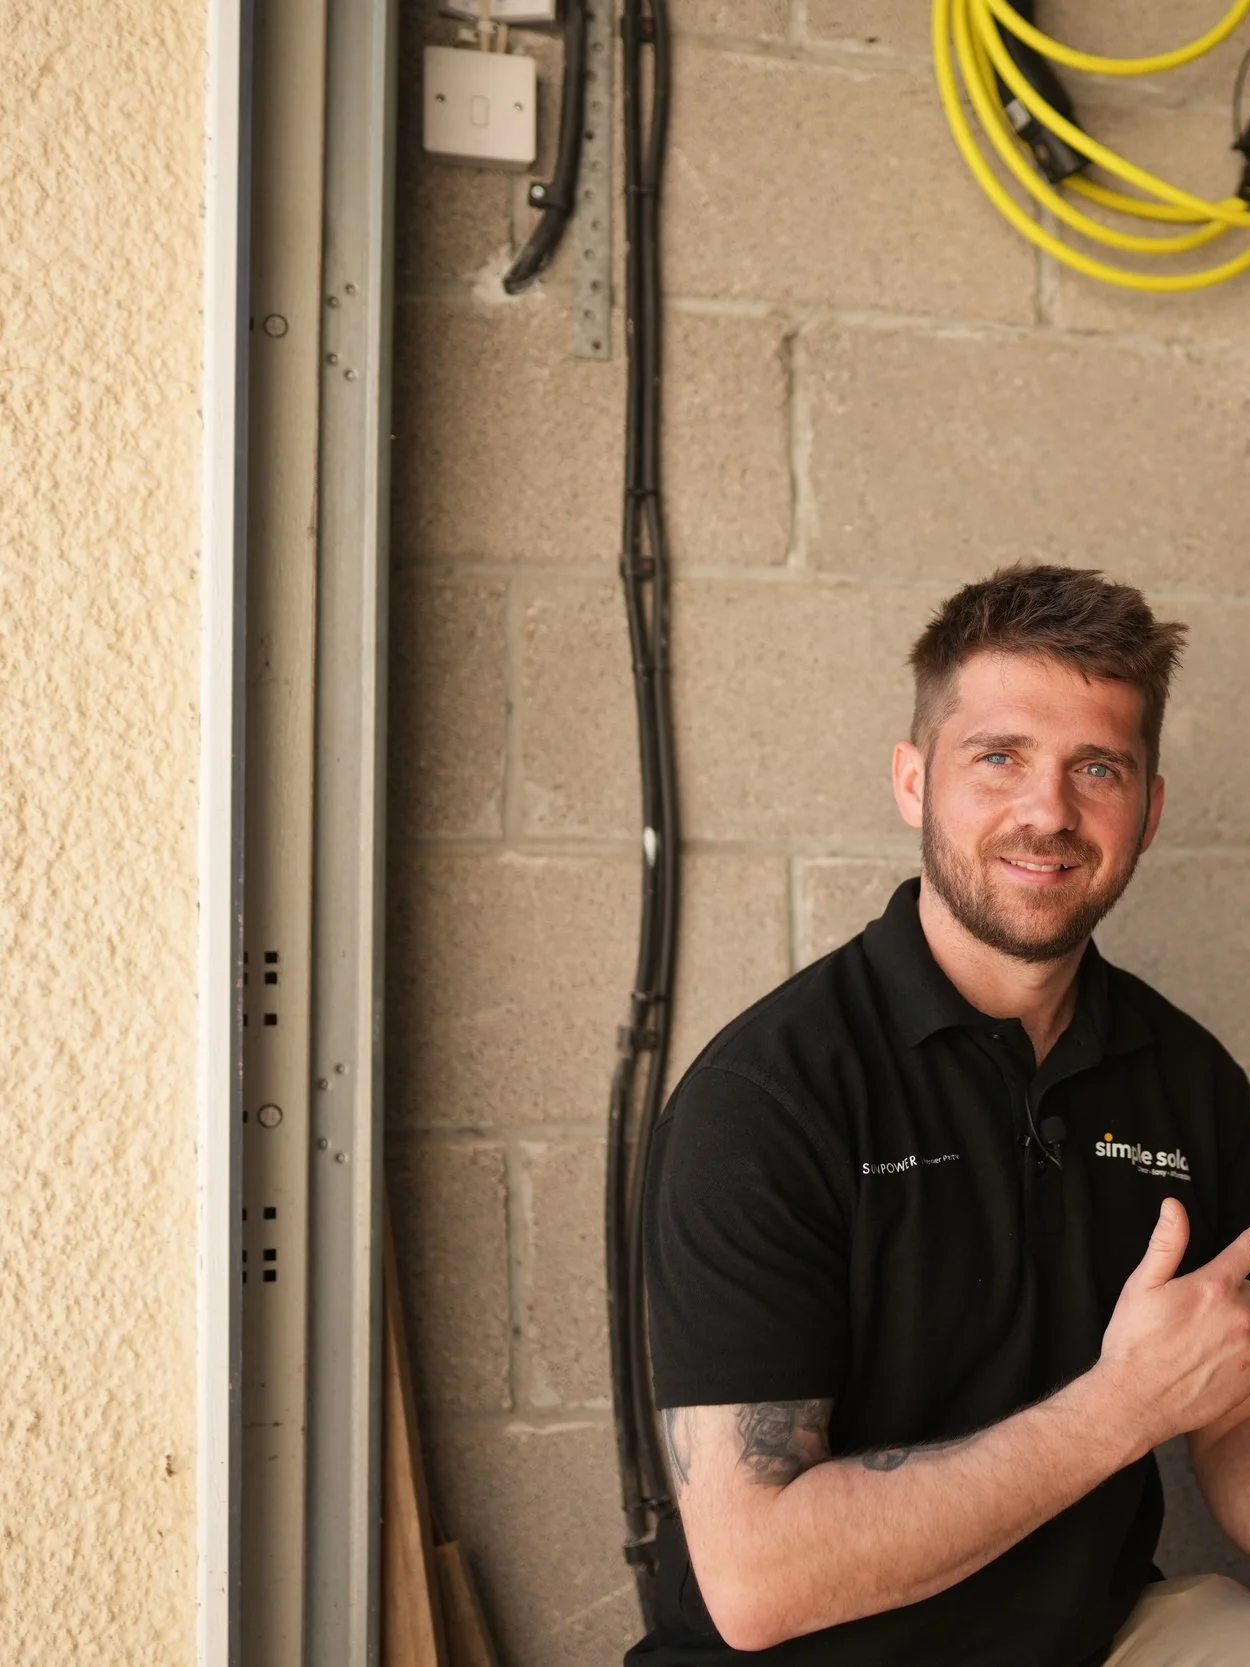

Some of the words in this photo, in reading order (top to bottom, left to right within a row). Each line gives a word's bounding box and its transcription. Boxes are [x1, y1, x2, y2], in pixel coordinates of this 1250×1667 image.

[862, 1155, 918, 1175] SUNPOWER
[1095, 1132, 1153, 1165] simple
[1156, 1148, 1190, 1171] sola
